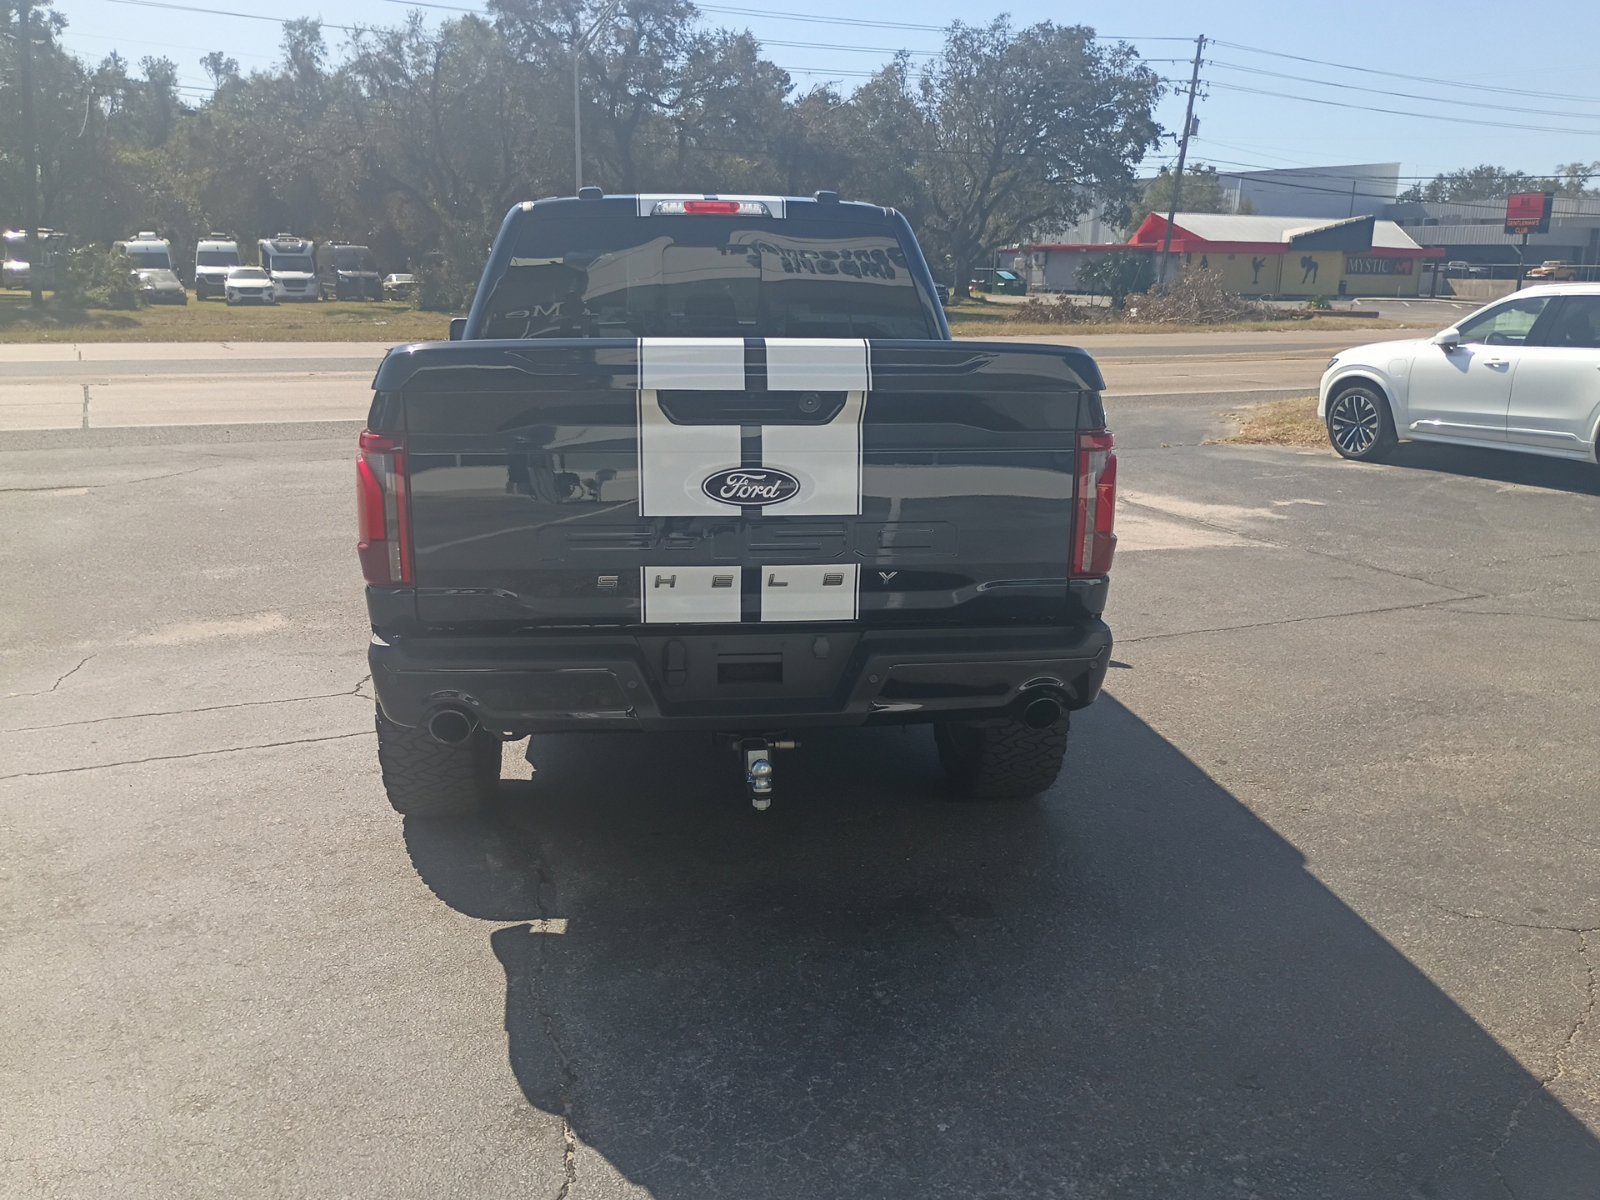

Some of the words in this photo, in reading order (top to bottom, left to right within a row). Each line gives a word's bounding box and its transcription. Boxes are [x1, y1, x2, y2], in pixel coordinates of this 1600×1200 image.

[1347, 258, 1390, 273] MYSTIC
[719, 472, 782, 499] Ford
[596, 569, 898, 590] SHELBY
